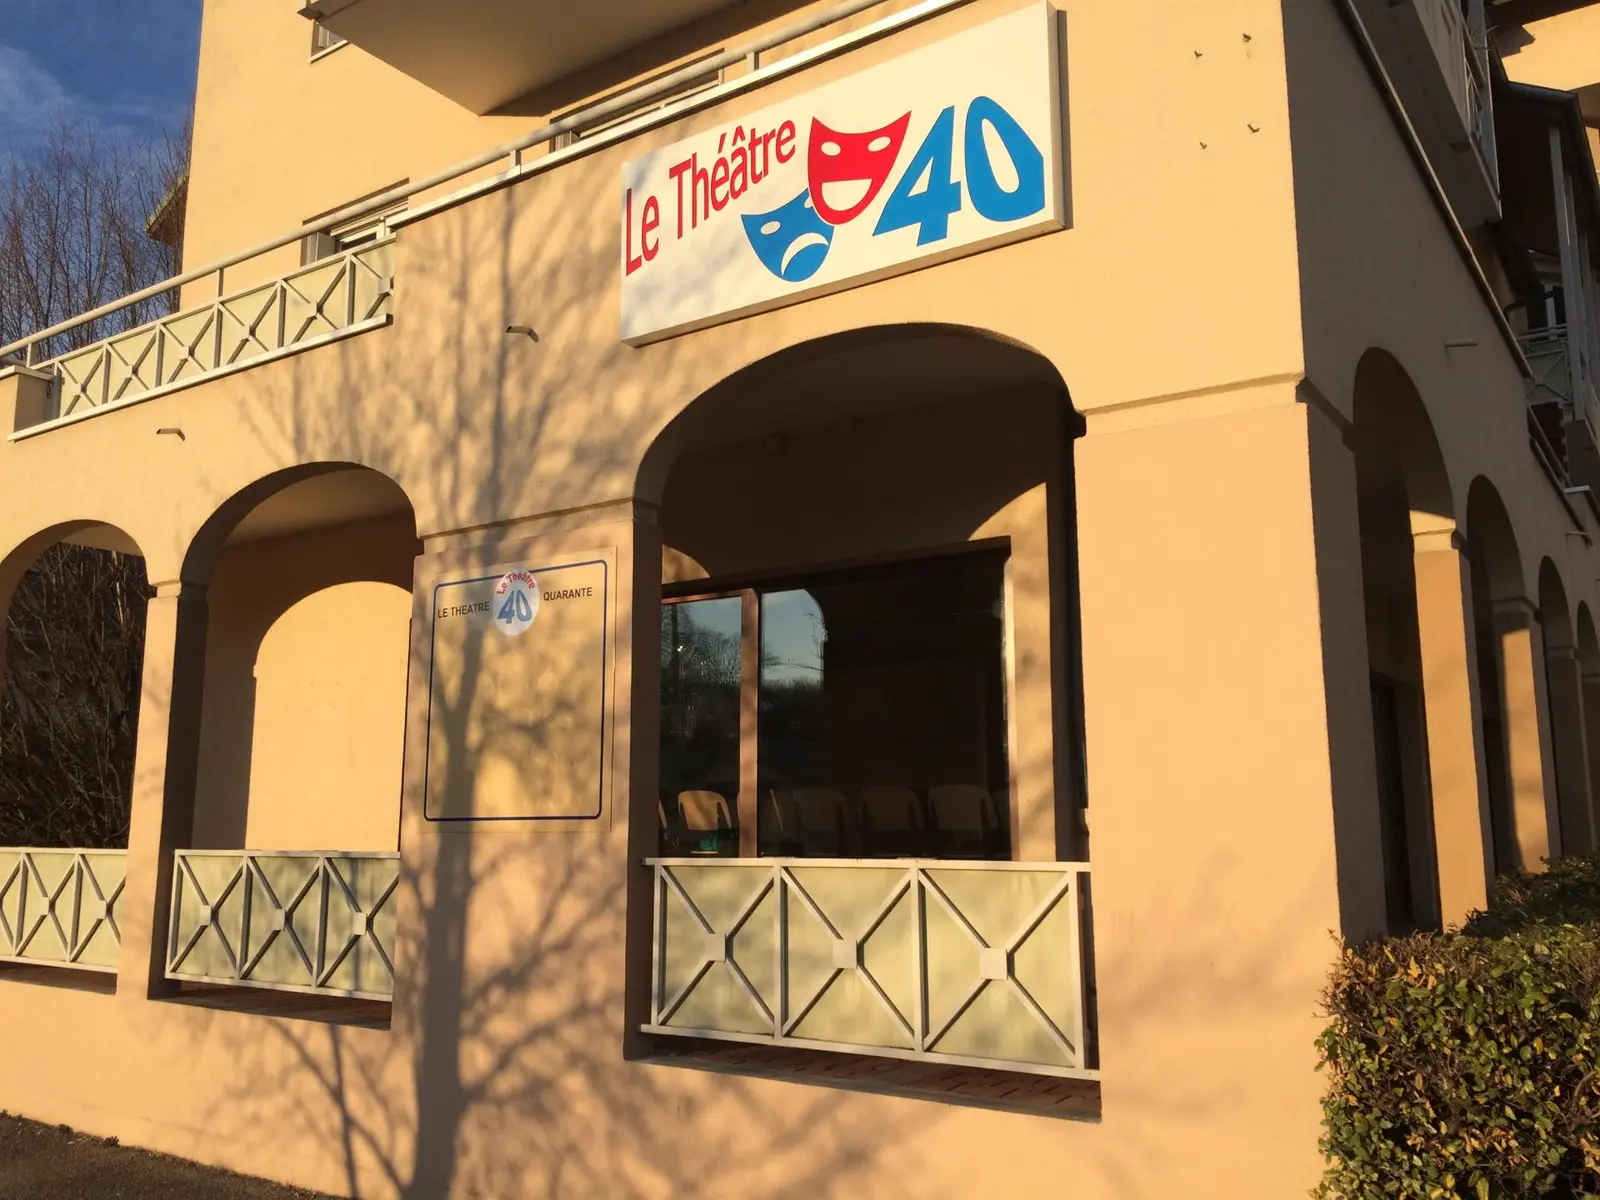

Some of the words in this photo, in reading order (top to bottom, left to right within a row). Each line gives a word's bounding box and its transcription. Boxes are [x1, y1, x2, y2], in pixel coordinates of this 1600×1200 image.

[872, 95, 1046, 247] 40
[626, 188, 660, 277] Le
[669, 119, 796, 241] Théâtre
[496, 582, 508, 595] Le
[543, 587, 593, 601] QUARANTE
[437, 607, 449, 618] LE
[450, 601, 490, 615] THEATRE
[497, 589, 532, 624] 40
